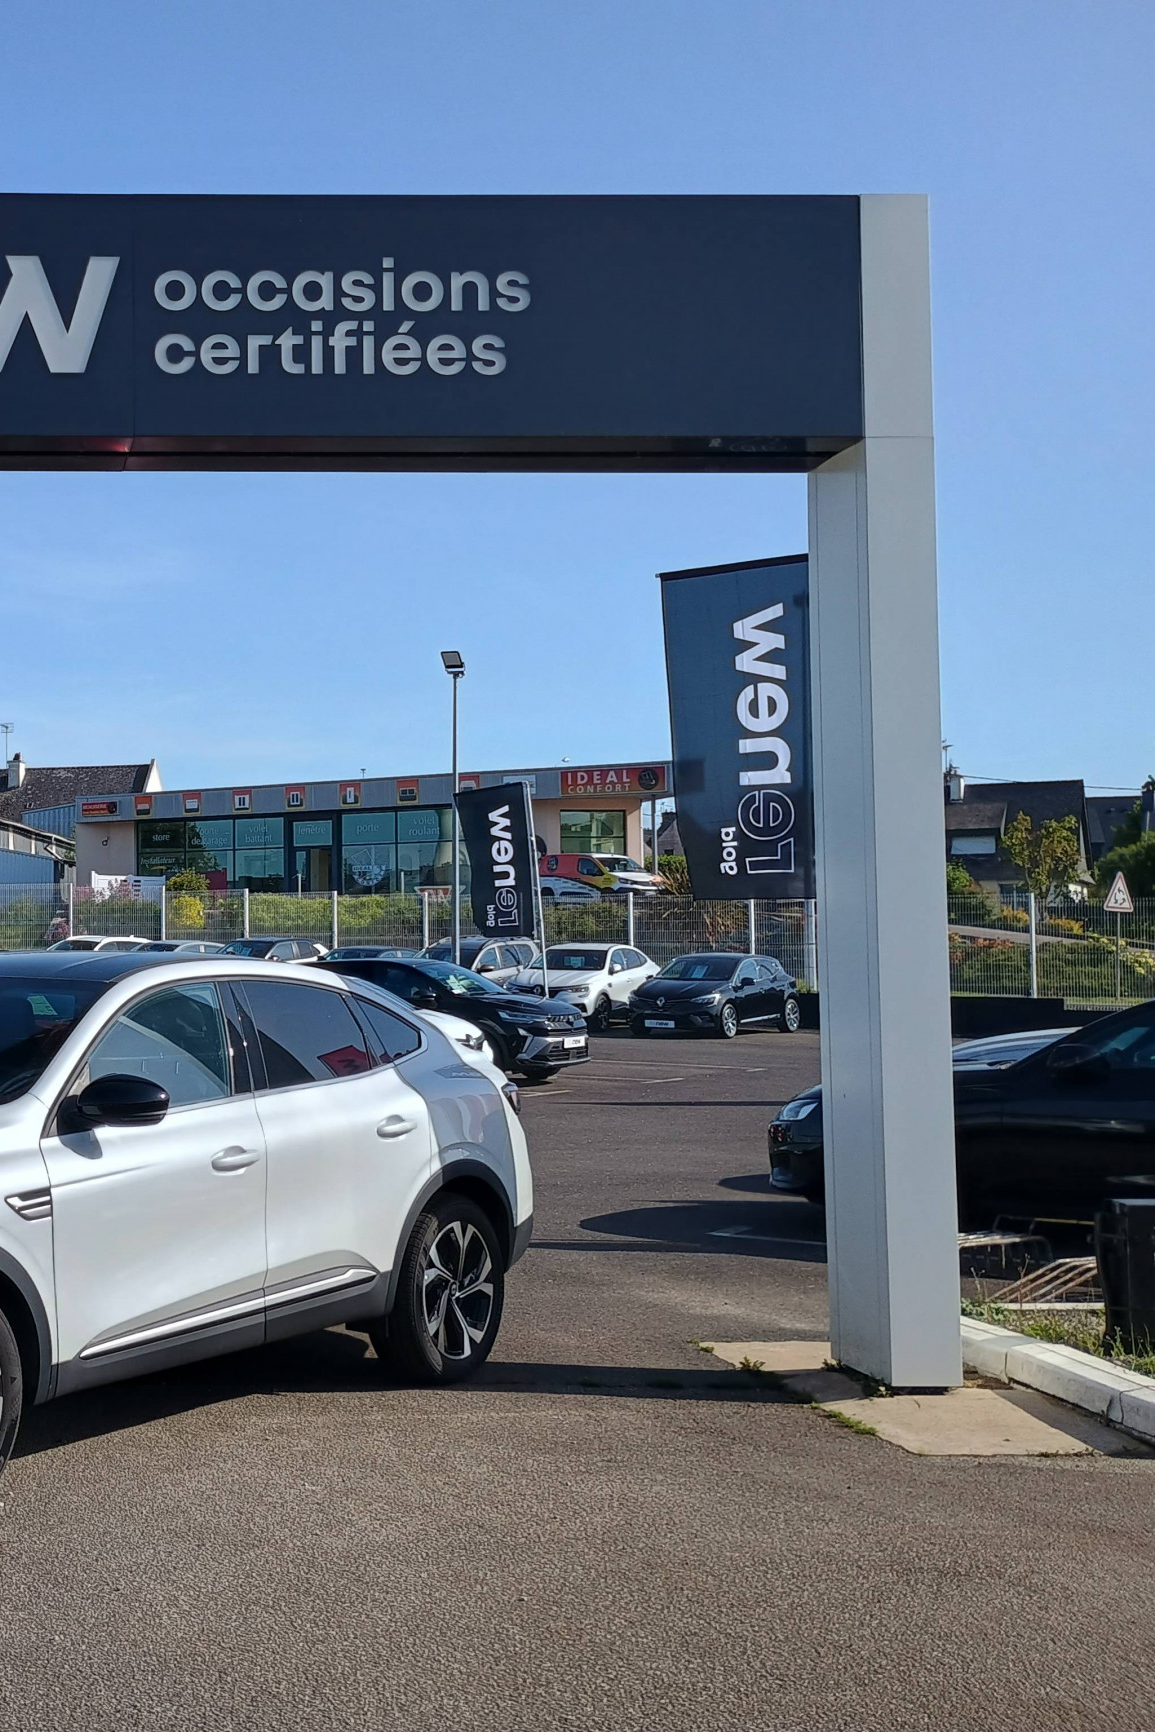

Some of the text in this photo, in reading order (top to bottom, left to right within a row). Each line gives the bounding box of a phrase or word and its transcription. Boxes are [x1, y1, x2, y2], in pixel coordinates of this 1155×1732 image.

[154, 256, 532, 313] occasions
[154, 320, 508, 376] certifiées
[567, 769, 631, 785] IDEAL
[567, 783, 631, 794] CONFORT
[413, 816, 437, 825] volet
[248, 824, 269, 833] volet
[356, 824, 380, 835] porte
[408, 825, 440, 836] roulant
[152, 833, 170, 842] store
[191, 836, 228, 848] de garage
[245, 834, 273, 844] battant
